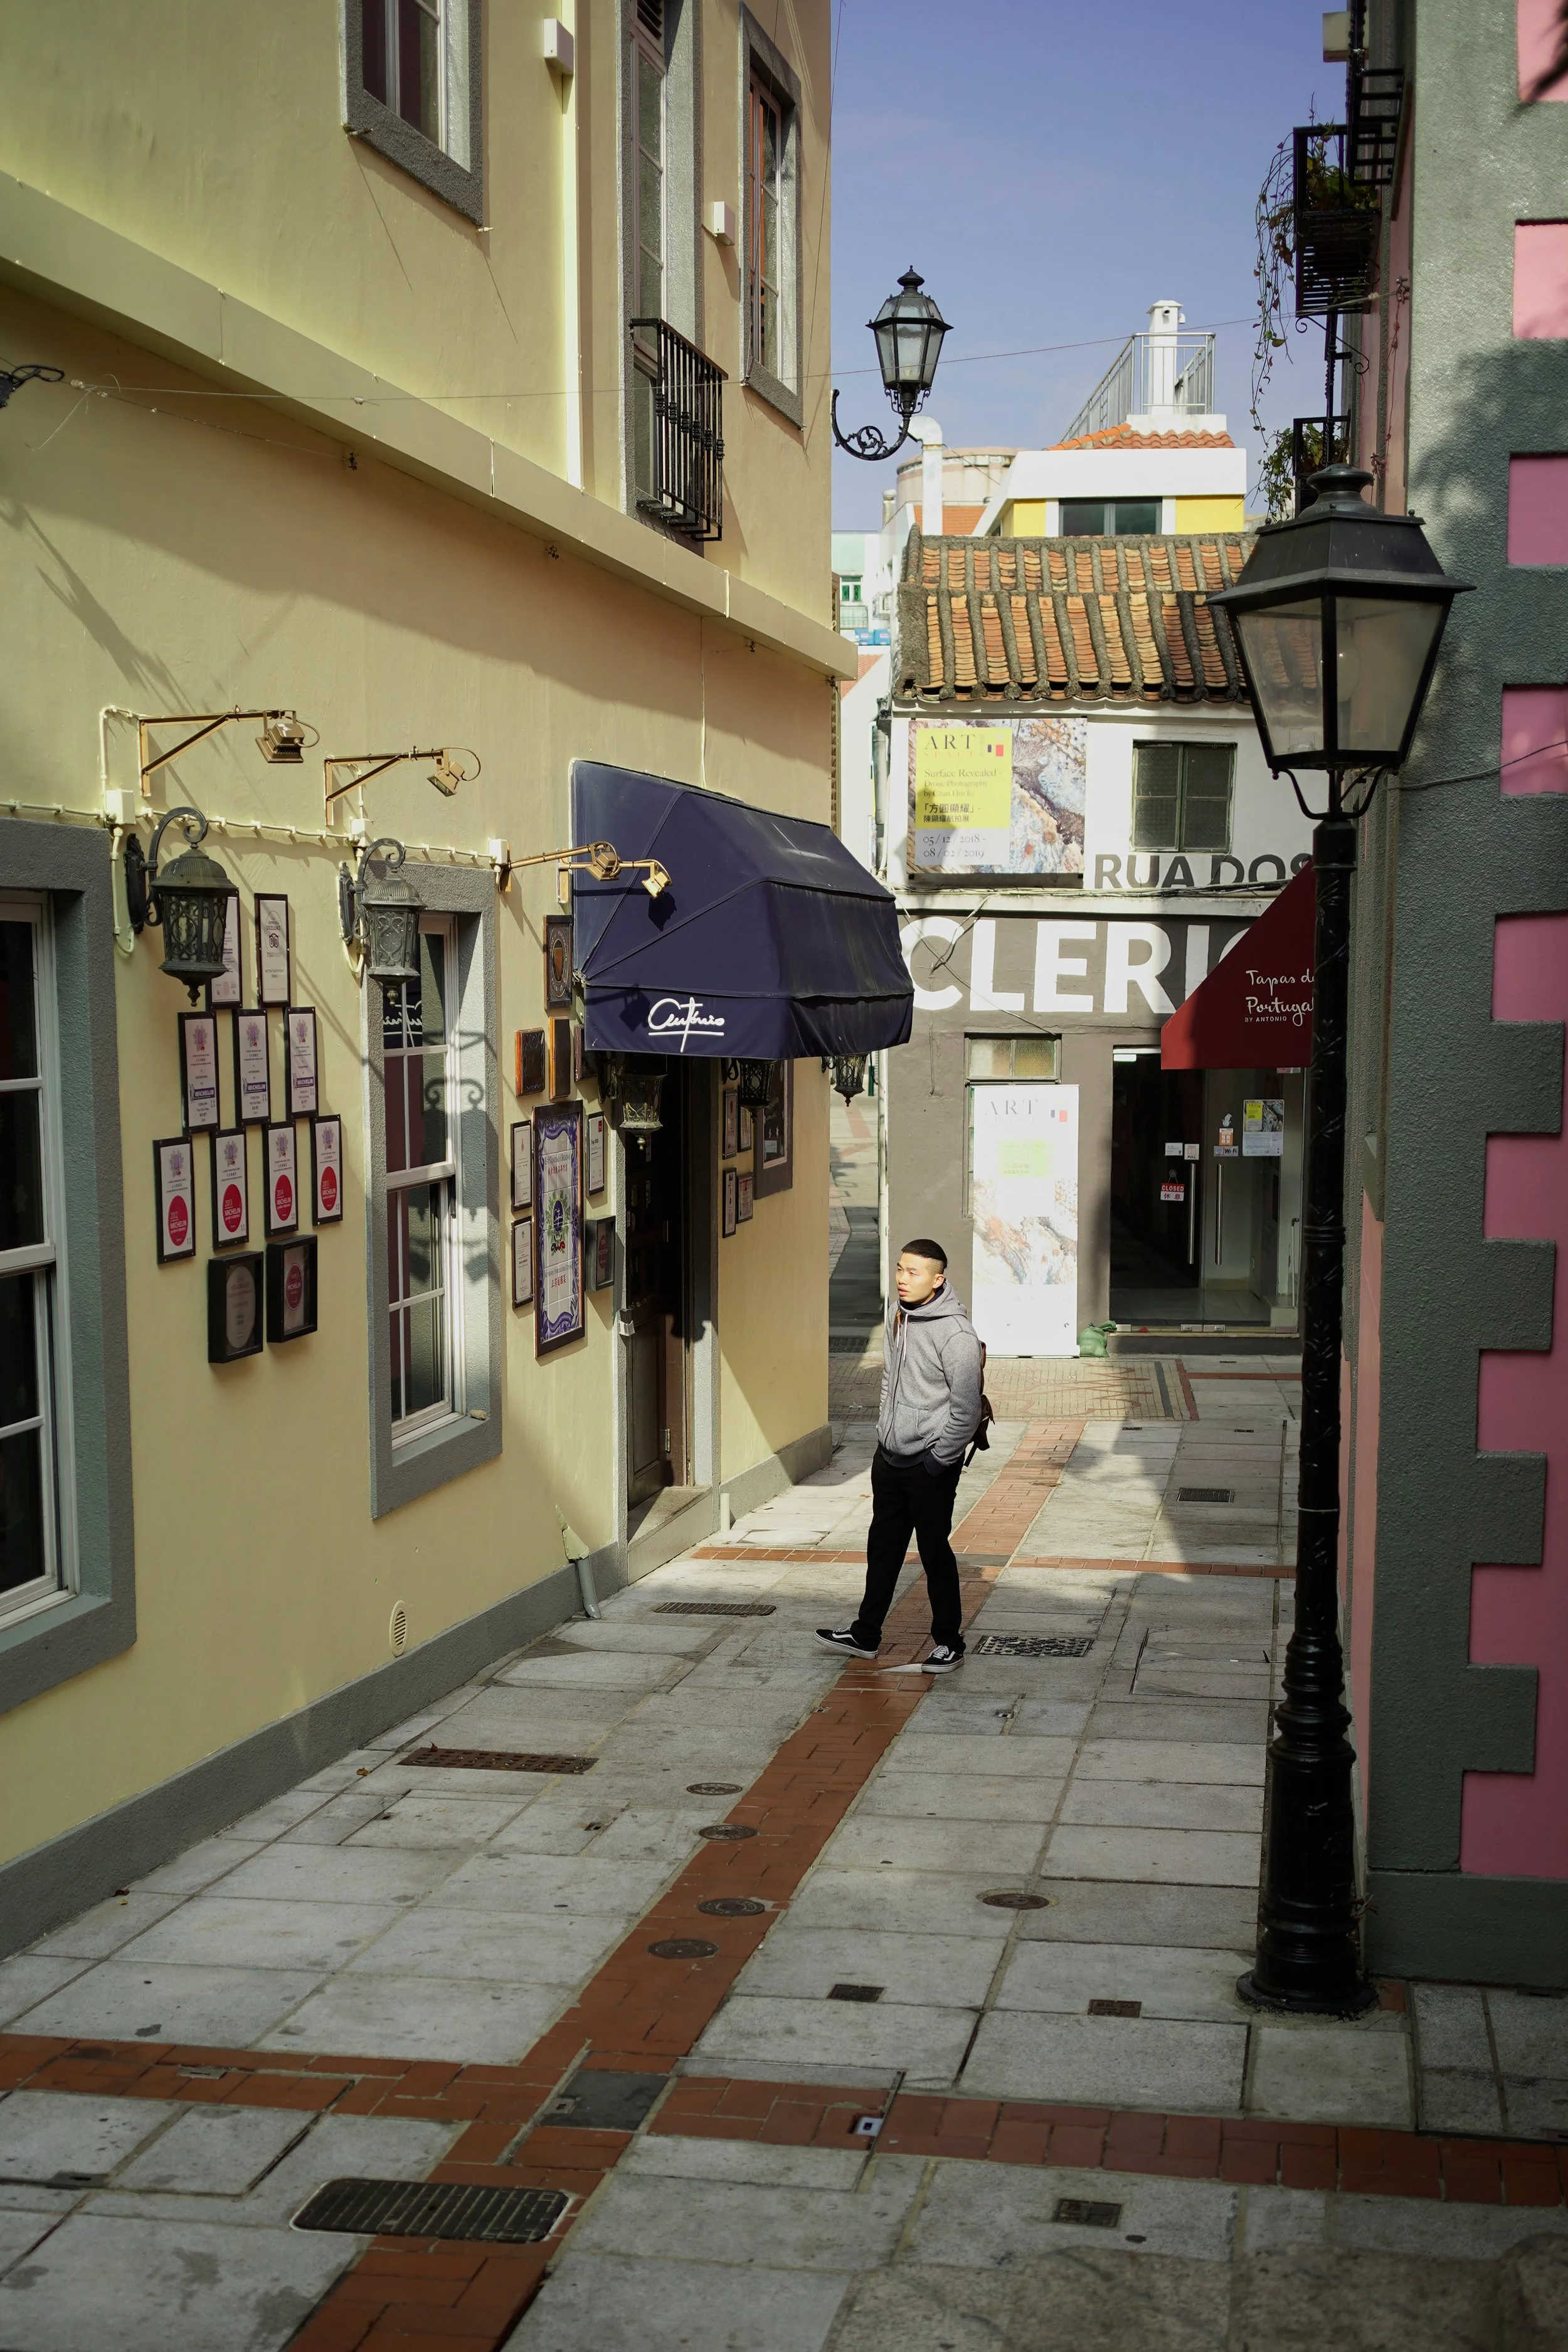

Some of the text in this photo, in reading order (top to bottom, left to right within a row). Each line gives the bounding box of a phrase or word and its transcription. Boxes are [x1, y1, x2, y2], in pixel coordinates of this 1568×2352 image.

[925, 734, 976, 750] ART
[924, 769, 956, 777] Surface
[958, 768, 997, 777] Revealed
[946, 780, 987, 788] Photography
[923, 790, 932, 798] by
[1094, 854, 1195, 889] RUA
[898, 916, 1254, 1014] CLERI
[1246, 968, 1315, 997] Tapas d
[985, 1099, 1038, 1115] ART
